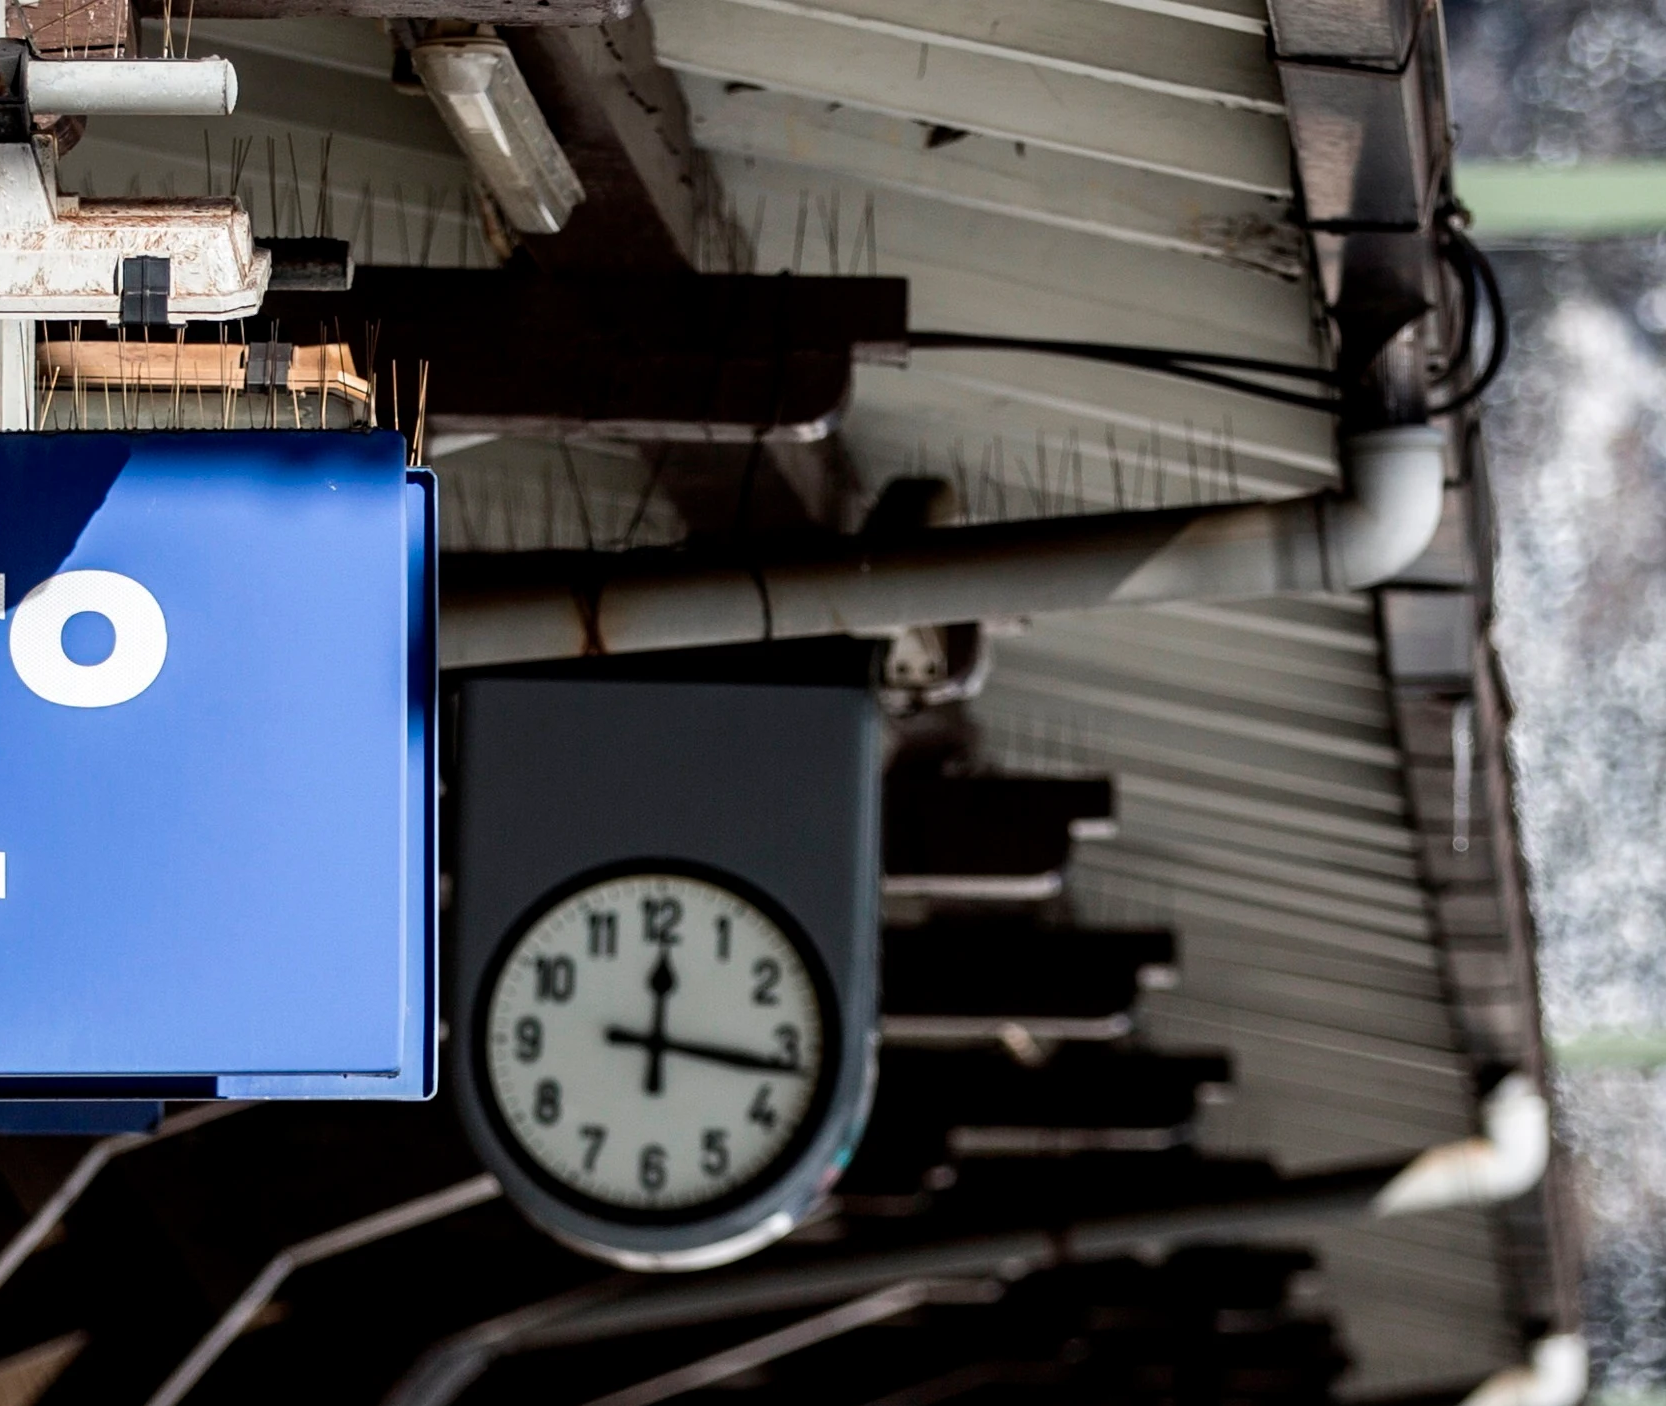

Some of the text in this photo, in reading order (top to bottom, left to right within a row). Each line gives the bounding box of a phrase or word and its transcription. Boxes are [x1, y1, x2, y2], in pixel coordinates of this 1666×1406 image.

[587, 913, 618, 957] 11
[641, 900, 681, 944] 12
[714, 915, 730, 960] 1
[536, 955, 575, 1002] 10
[752, 958, 781, 1005] 2
[515, 1017, 543, 1062] 9
[773, 1025, 800, 1068] 3
[533, 1079, 562, 1126] 8
[747, 1083, 778, 1129] 4
[579, 1126, 608, 1171] 7
[639, 1144, 667, 1190] 6
[701, 1130, 730, 1176] 5
